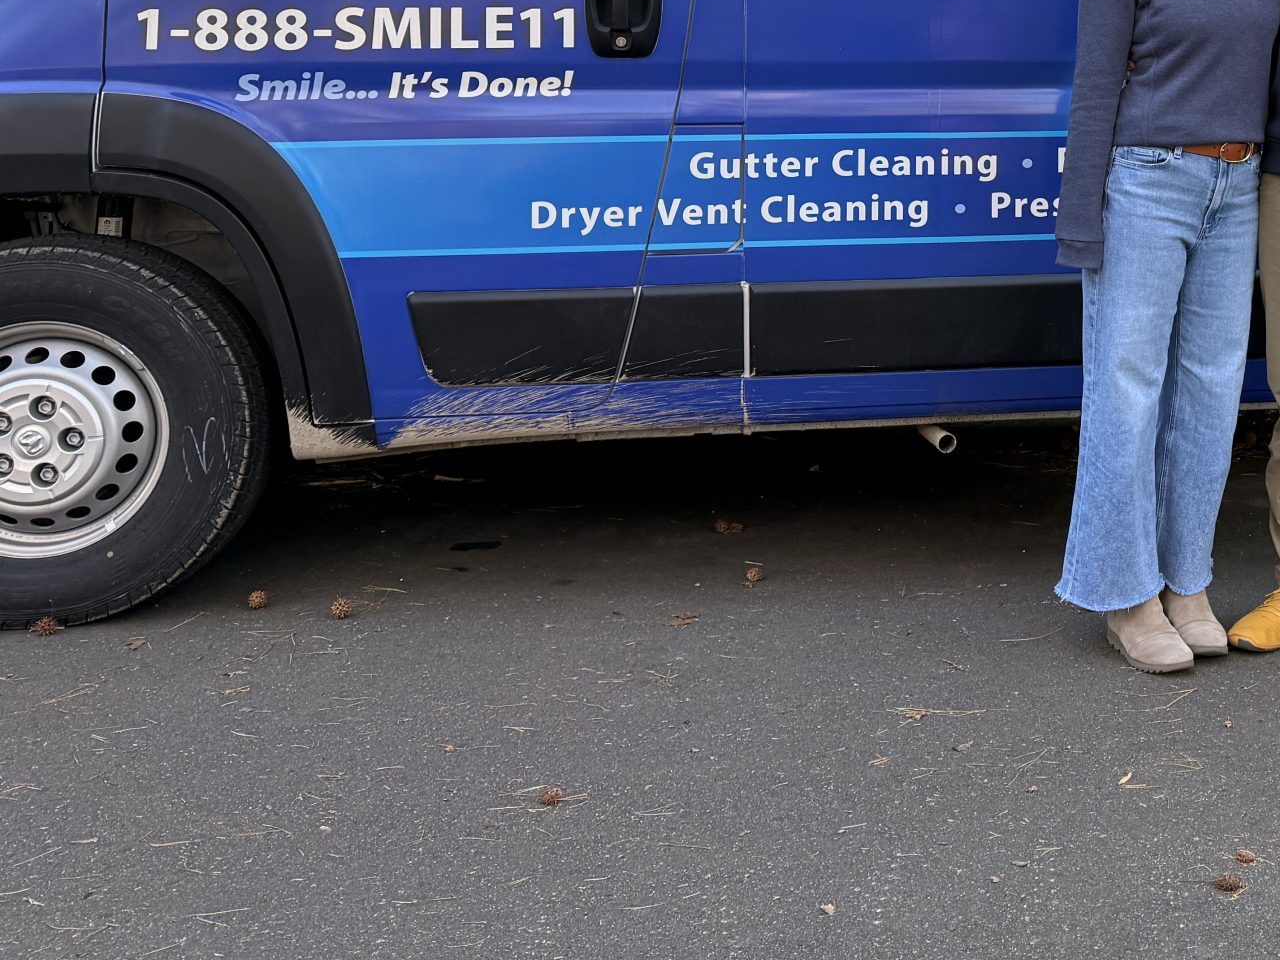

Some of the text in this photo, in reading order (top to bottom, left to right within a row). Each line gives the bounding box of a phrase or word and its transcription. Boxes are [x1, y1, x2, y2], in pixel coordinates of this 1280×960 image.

[136, 5, 577, 52] 1-888-SMILE11
[234, 71, 379, 102] Smile...
[457, 69, 575, 98] Done!
[689, 147, 998, 182] Gutter Cleaning
[530, 199, 643, 236] Dryer
[657, 197, 748, 226] Vent
[760, 193, 930, 228] Cleaning
